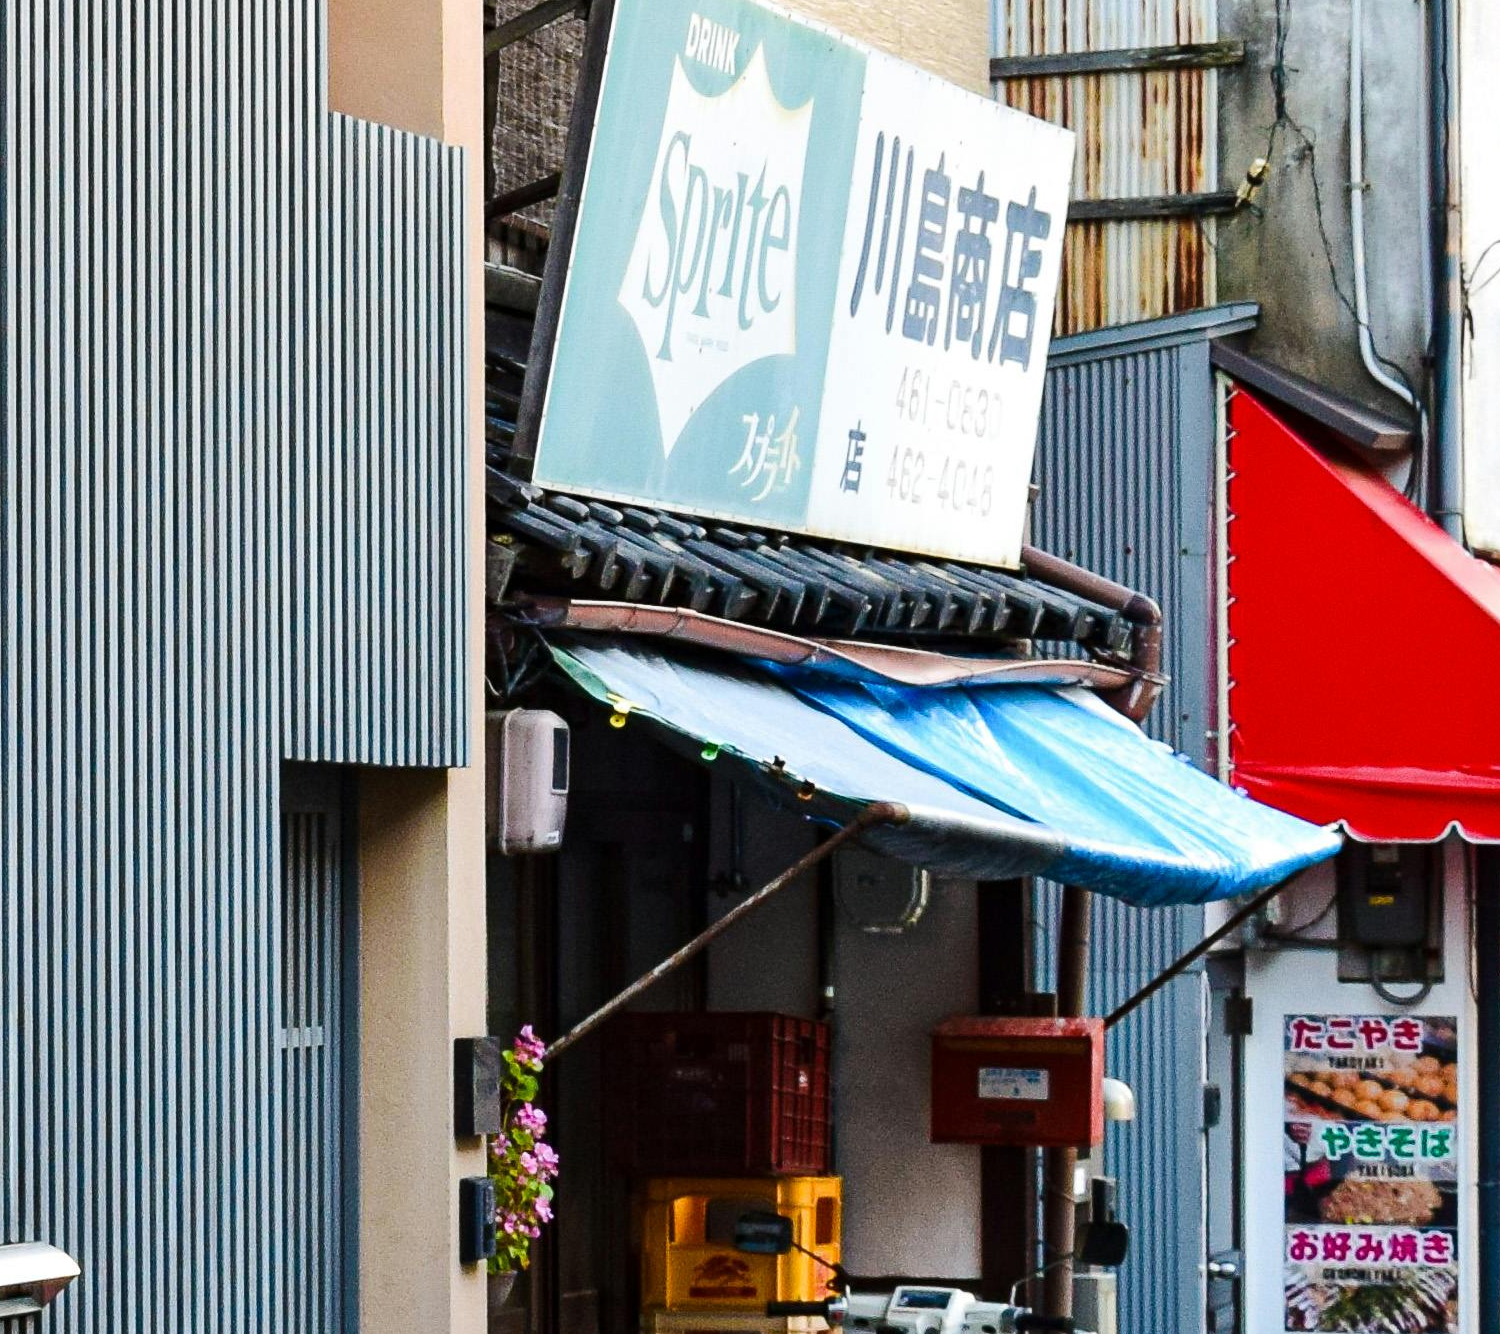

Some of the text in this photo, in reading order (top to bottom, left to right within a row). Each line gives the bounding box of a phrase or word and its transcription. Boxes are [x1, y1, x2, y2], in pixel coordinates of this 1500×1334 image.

[684, 12, 740, 77] DRINK
[641, 130, 791, 361] Sprite
[849, 129, 1053, 373] 川島商店
[727, 404, 802, 501] スプライト
[840, 418, 867, 495] 店
[1291, 1018, 1421, 1051] たこやき
[1320, 1126, 1452, 1159] やきそば
[1289, 1232, 1451, 1264] お好み焼き
